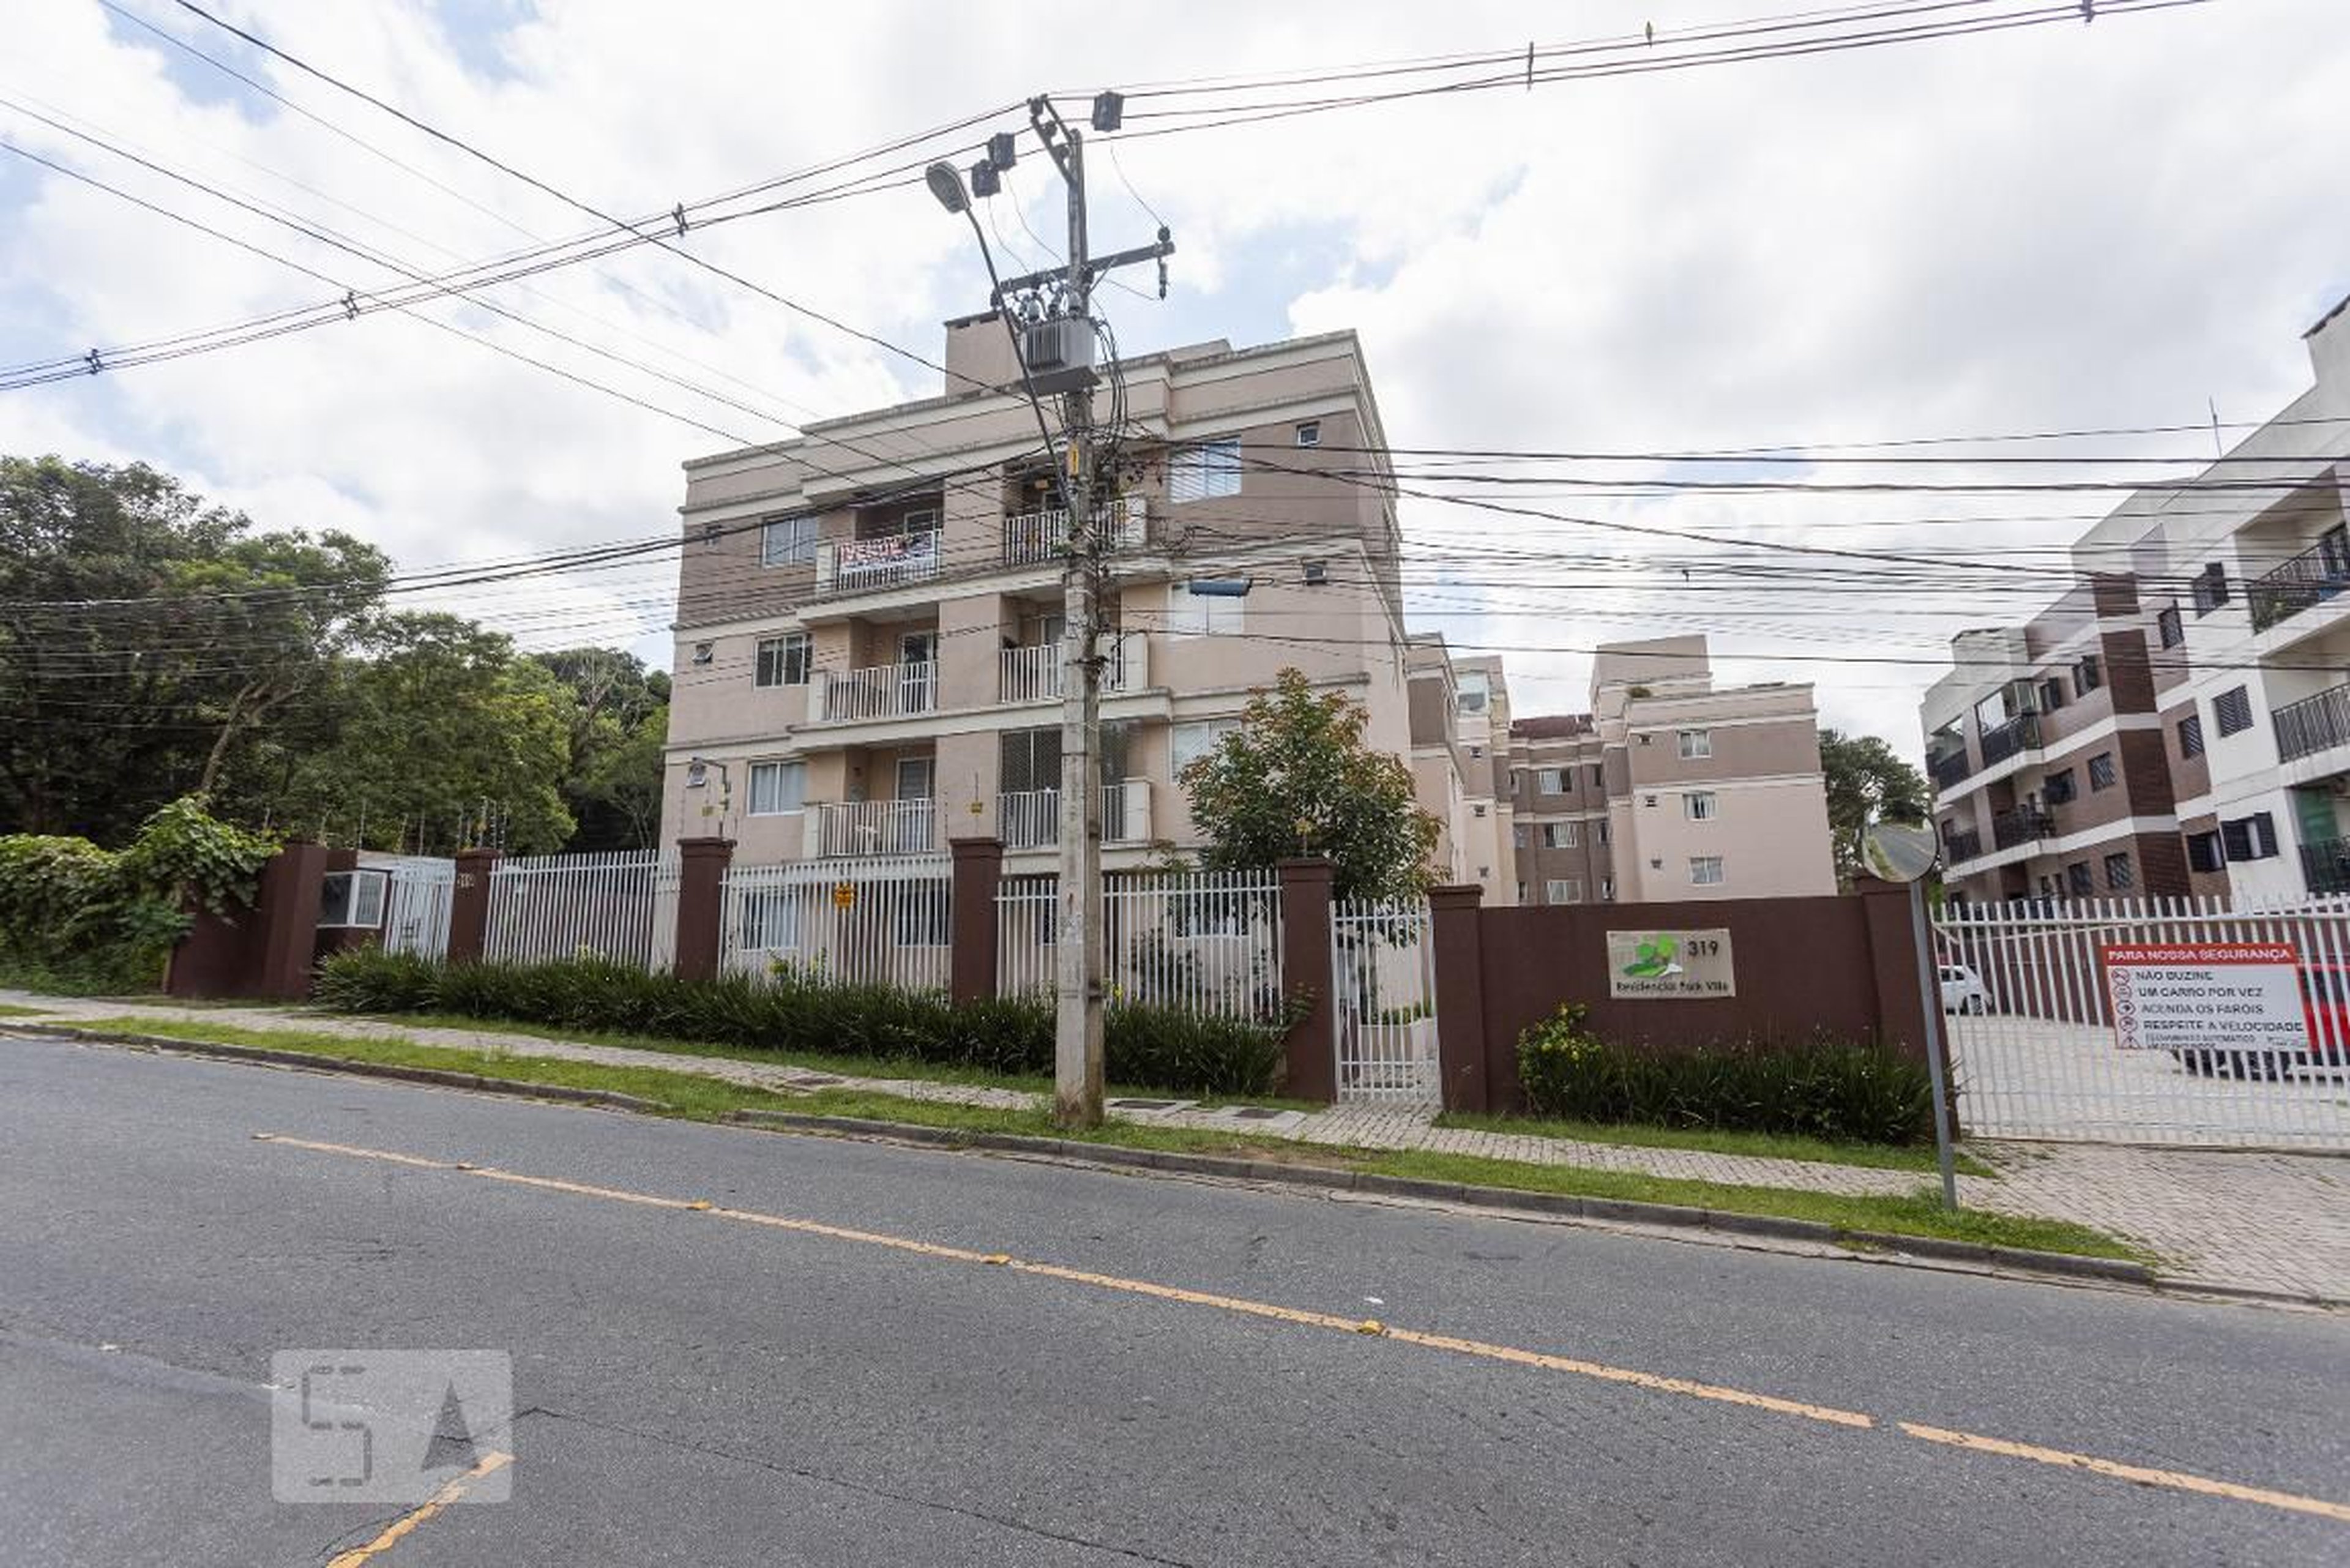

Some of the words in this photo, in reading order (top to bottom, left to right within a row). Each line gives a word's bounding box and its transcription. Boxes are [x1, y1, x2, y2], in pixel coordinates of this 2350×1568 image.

[1688, 940, 1718, 957] 319
[2108, 950, 2145, 960] PARA
[2147, 950, 2197, 960] NOSSA
[2199, 949, 2291, 961] SEGURANÇA
[2166, 971, 2214, 980] BUZINE
[2138, 987, 2158, 997] UM
[2160, 987, 2206, 997] CARRO
[2208, 987, 2236, 997] POR
[2237, 987, 2263, 997] VEZ
[2142, 1004, 2194, 1014] ACENDA
[2196, 1004, 2214, 1014] OS
[2143, 1020, 2203, 1029] RESPEITE
[2218, 1021, 2303, 1031] VELOCIDADE
